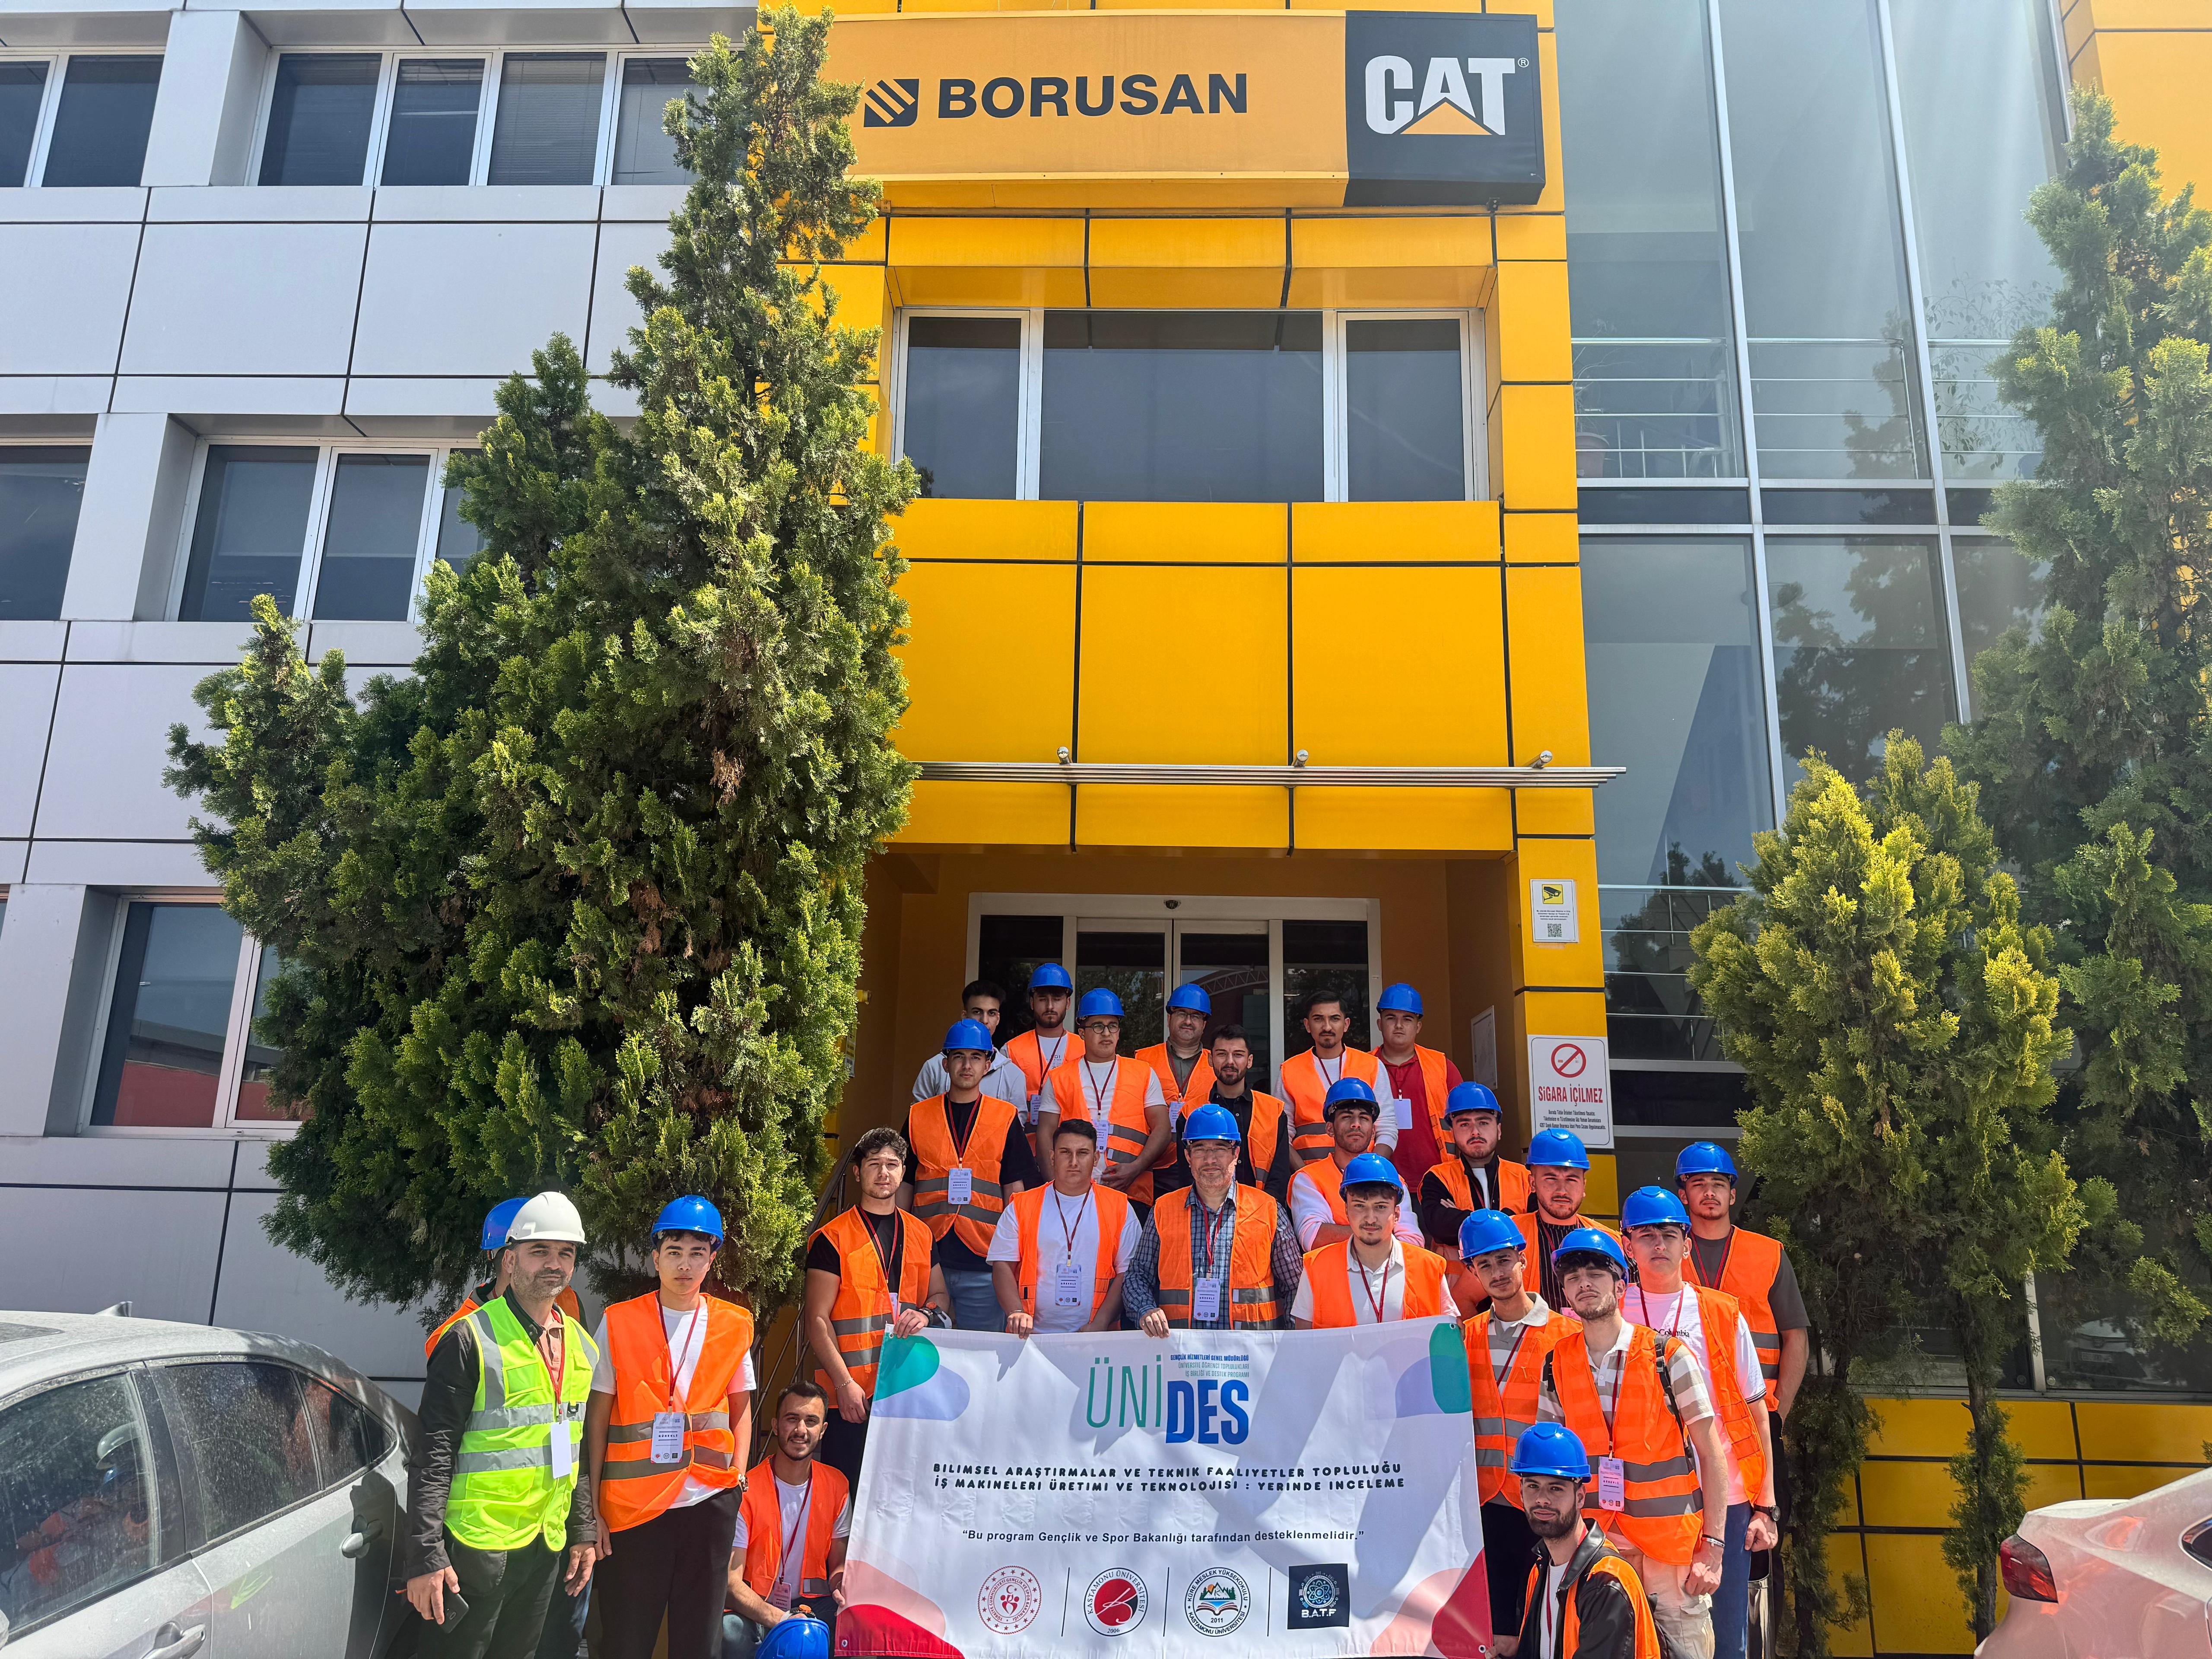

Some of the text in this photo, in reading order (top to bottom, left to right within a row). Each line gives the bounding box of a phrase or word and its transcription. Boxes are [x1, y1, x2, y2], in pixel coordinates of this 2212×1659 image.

[938, 73, 1247, 118] BORUSAN
[1366, 55, 1515, 135] CAT
[1570, 1084, 1603, 1106] İÇİLMEZ
[1166, 1379, 1249, 1444] DES
[933, 1461, 1401, 1478] BILIMSEL ARAŞTIRMALAR VE TEKNIK FAALIYETLER TOPLULUĞU
[935, 1475, 948, 1489] İŞ
[955, 1479, 1041, 1490] MAKINELERI
[1049, 1479, 1108, 1491] ÜRETIMI
[1116, 1482, 1133, 1491] VE
[1141, 1481, 1237, 1491] TEKNOLOJISI
[1258, 1482, 1321, 1491] YERINDE
[1329, 1478, 1405, 1490] INCELEME
[987, 1532, 1034, 1542] program
[1038, 1532, 1081, 1544] Gençlik
[1102, 1533, 1129, 1544] Spor
[1133, 1533, 1187, 1544] Bakanlığı
[1191, 1532, 1250, 1542] tarafından
[1087, 1571, 1113, 1614] KASTAMONU
[1188, 1569, 1248, 1602] KÜRE MESLEK YÜKSEKOKULU
[1189, 1612, 1214, 1634] KASTAMONU
